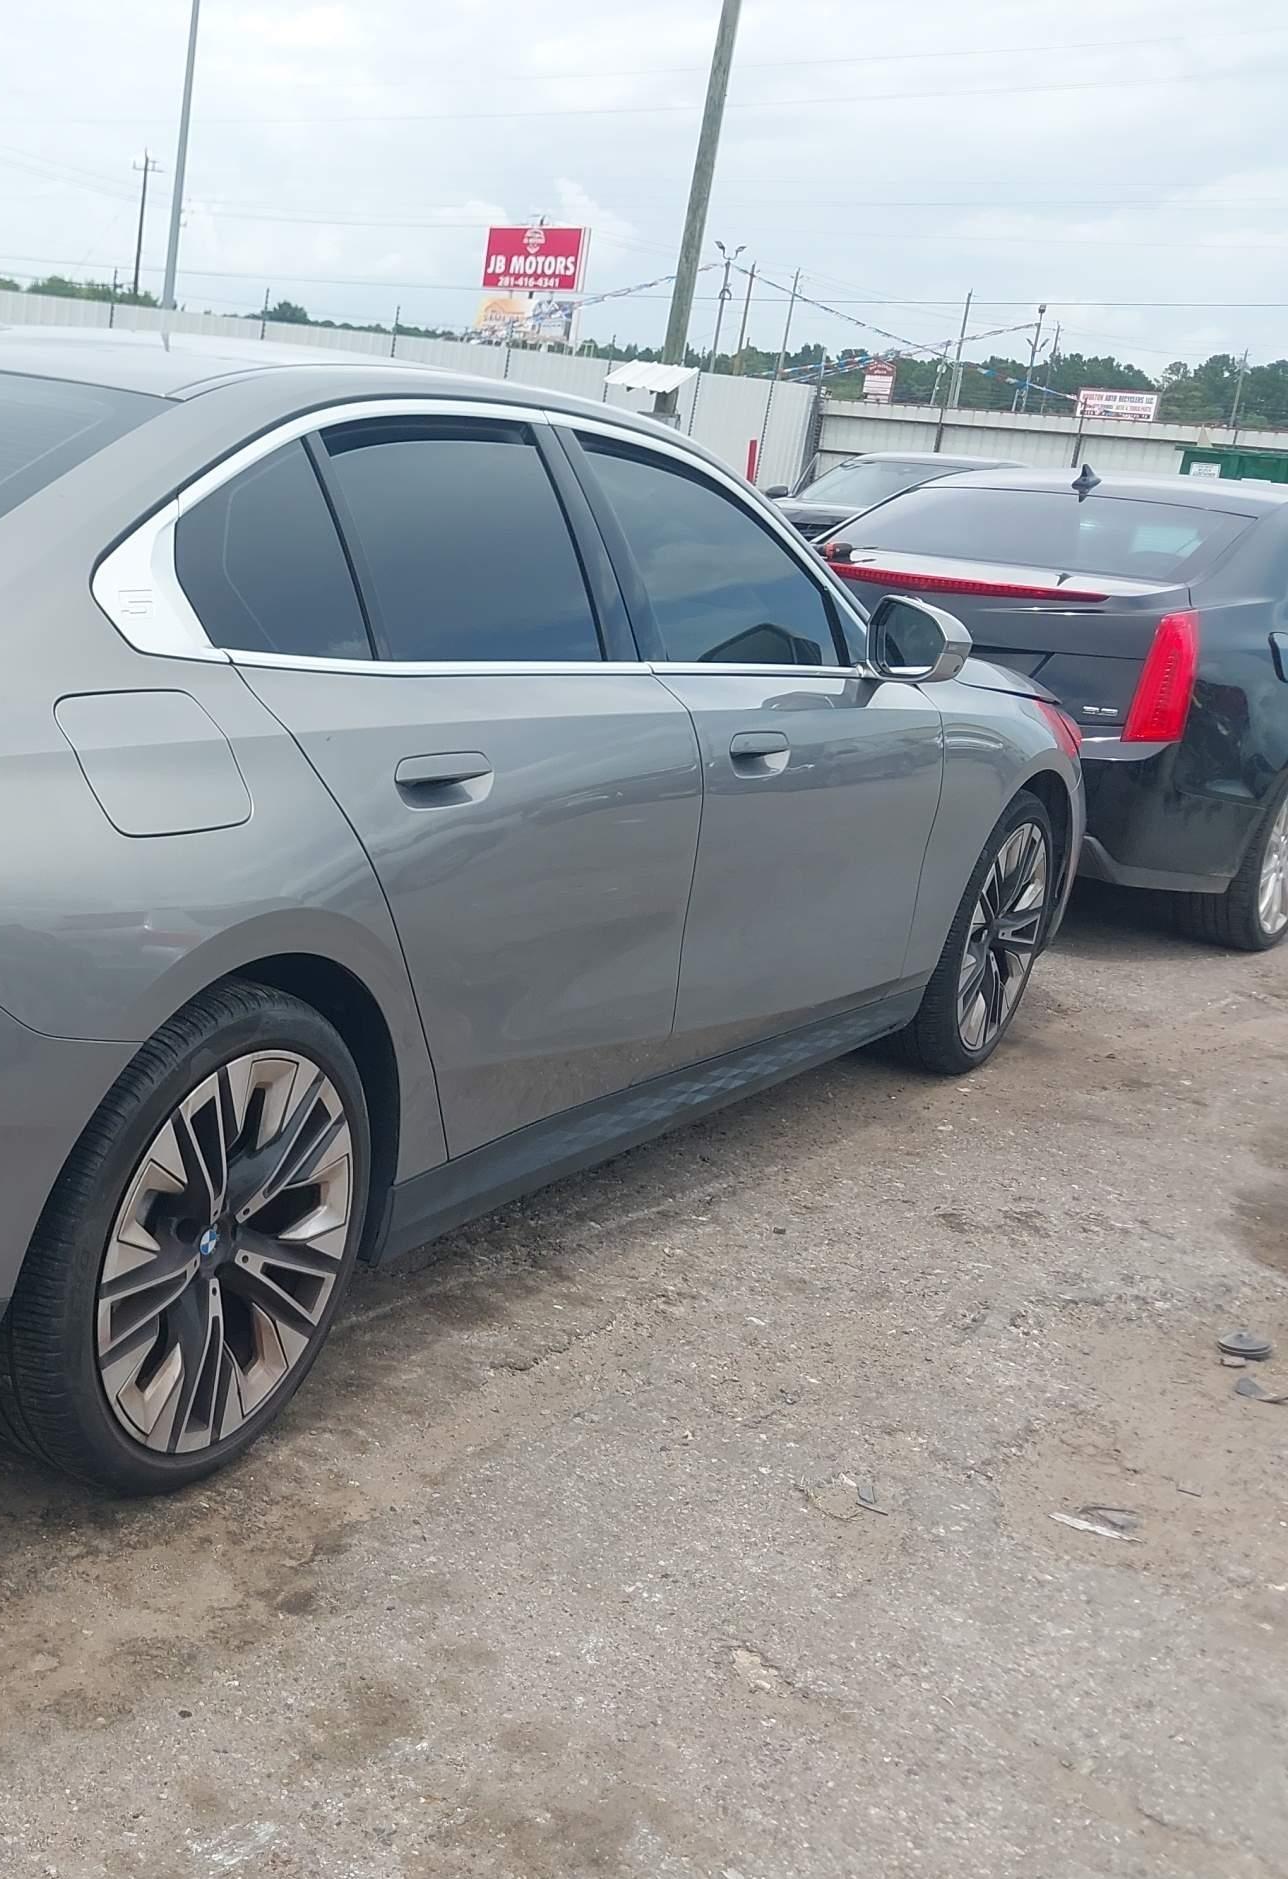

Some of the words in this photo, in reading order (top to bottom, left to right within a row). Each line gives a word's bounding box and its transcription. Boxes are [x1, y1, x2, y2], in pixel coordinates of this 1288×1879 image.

[487, 255, 506, 274] JB
[509, 255, 575, 275] MOTORS
[497, 276, 560, 288] 281-416-4341
